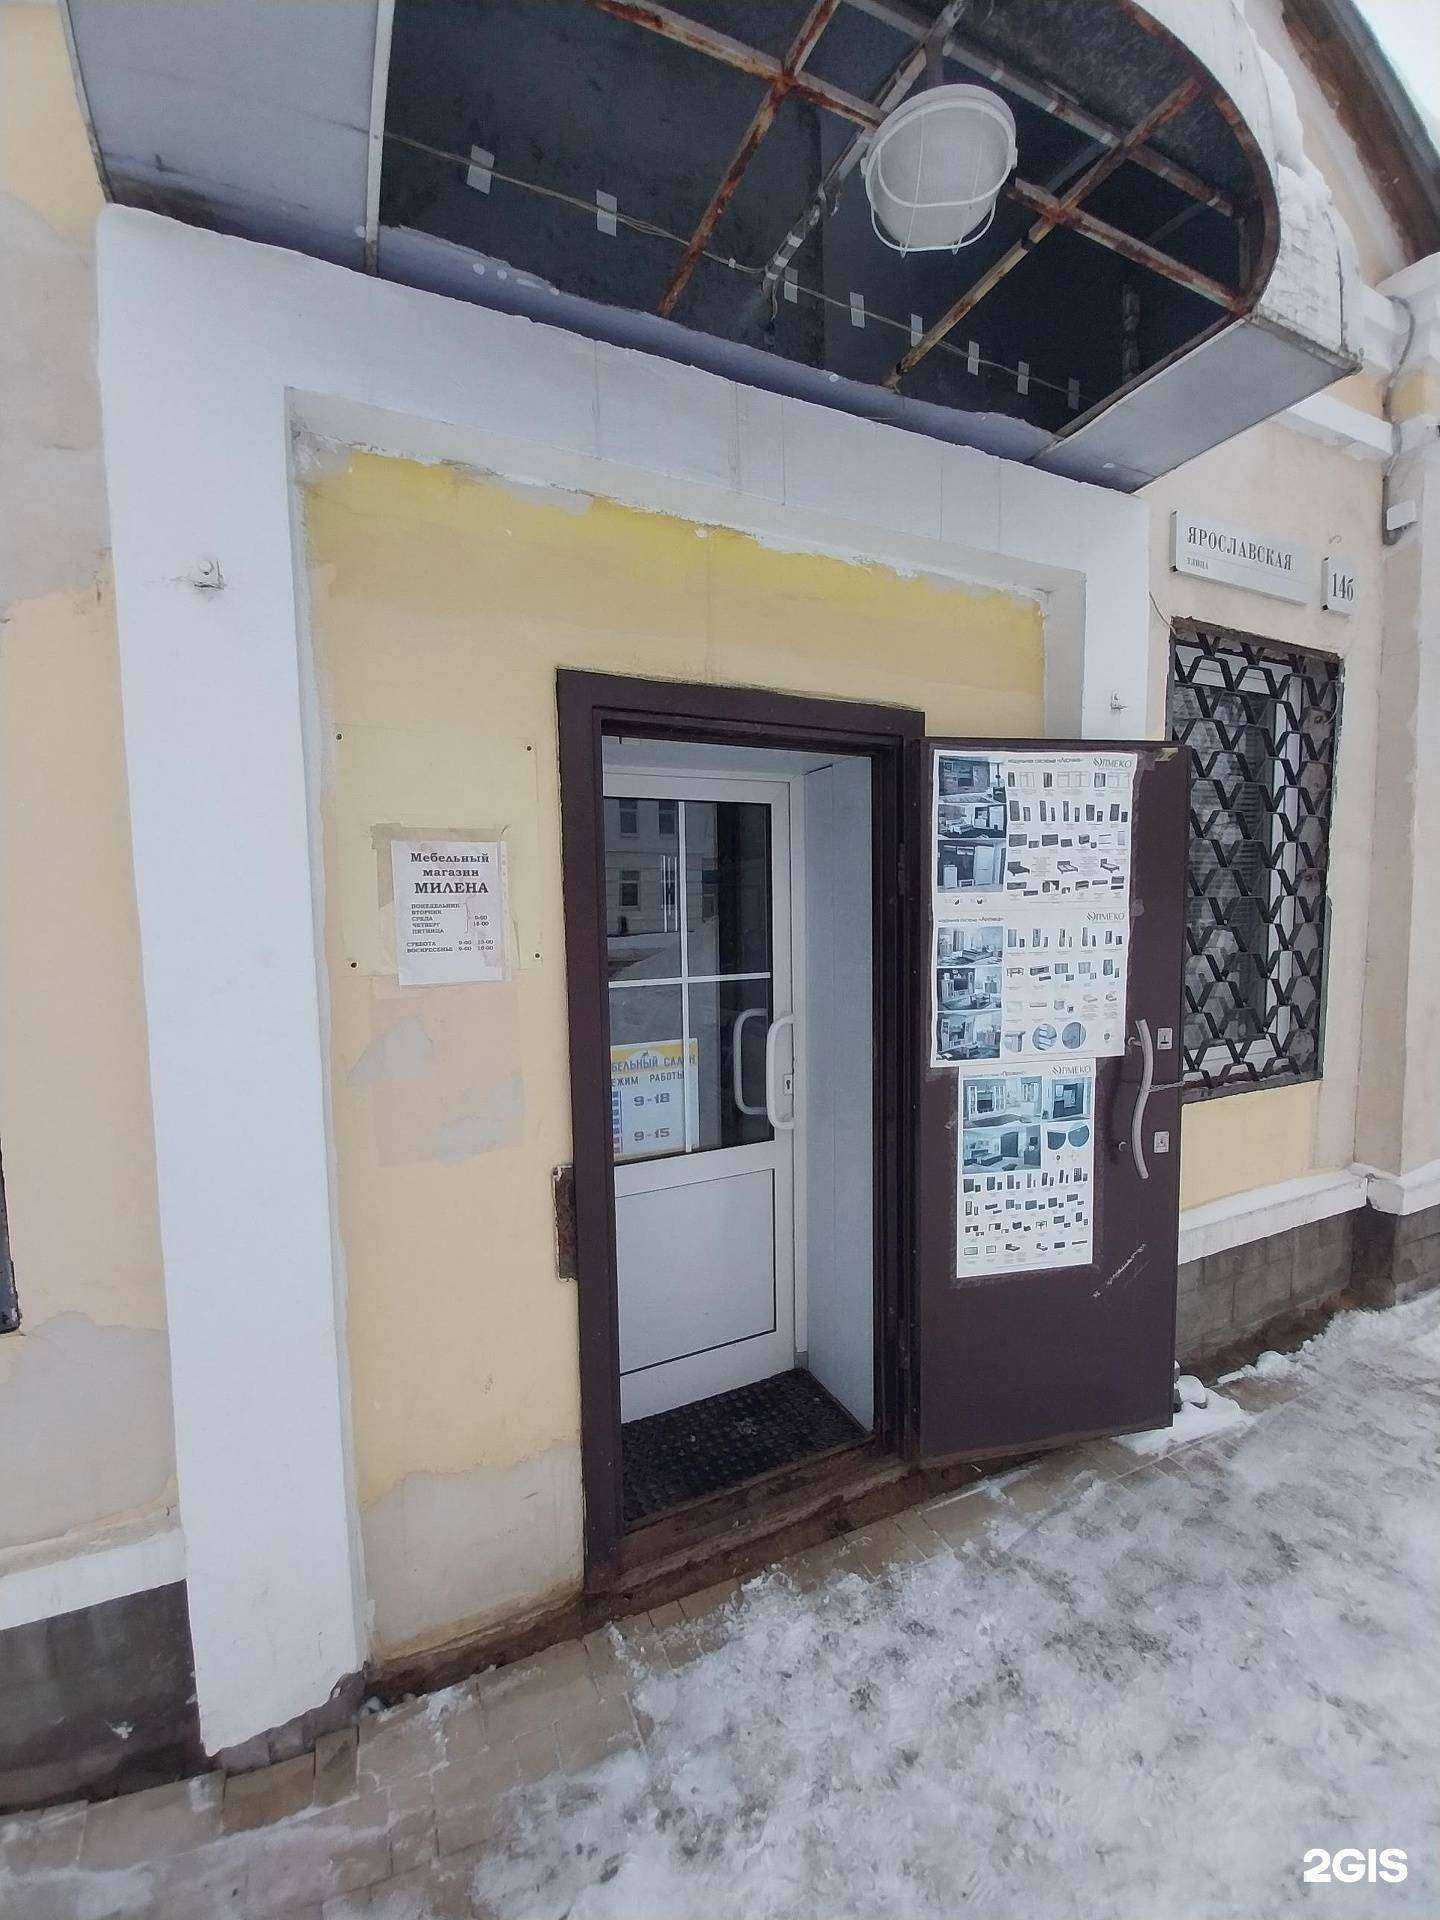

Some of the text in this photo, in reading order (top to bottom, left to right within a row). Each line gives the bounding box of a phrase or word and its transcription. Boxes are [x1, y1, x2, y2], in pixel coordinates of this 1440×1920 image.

[1187, 526, 1292, 571] ЯРОСЛАВСКАЯ
[410, 852, 490, 863] Мебельный
[422, 869, 480, 877] магазин
[414, 882, 489, 894] МИЛЕНА
[663, 1054, 696, 1068] САЛН
[649, 1071, 684, 1083] РАБОТЫ
